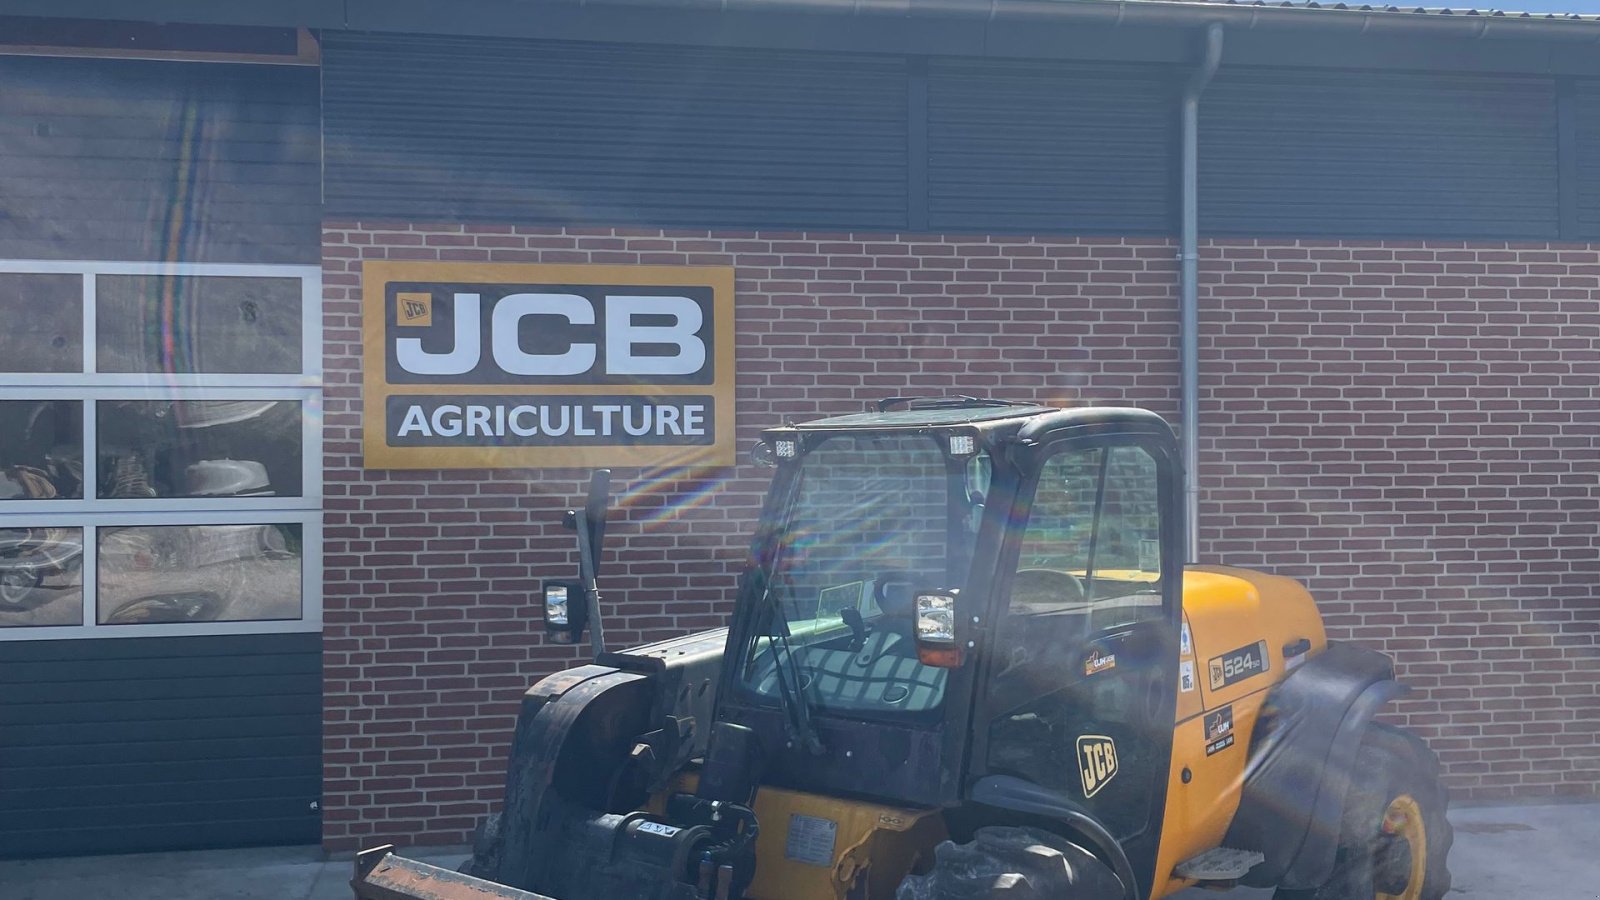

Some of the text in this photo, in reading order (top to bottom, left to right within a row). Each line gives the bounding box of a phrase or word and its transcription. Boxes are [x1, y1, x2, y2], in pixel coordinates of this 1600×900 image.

[405, 301, 427, 318] JCB
[396, 292, 706, 376] JCB
[397, 404, 705, 437] AGRICULTURE
[1224, 653, 1252, 677] 524
[1083, 742, 1115, 790] JCB
